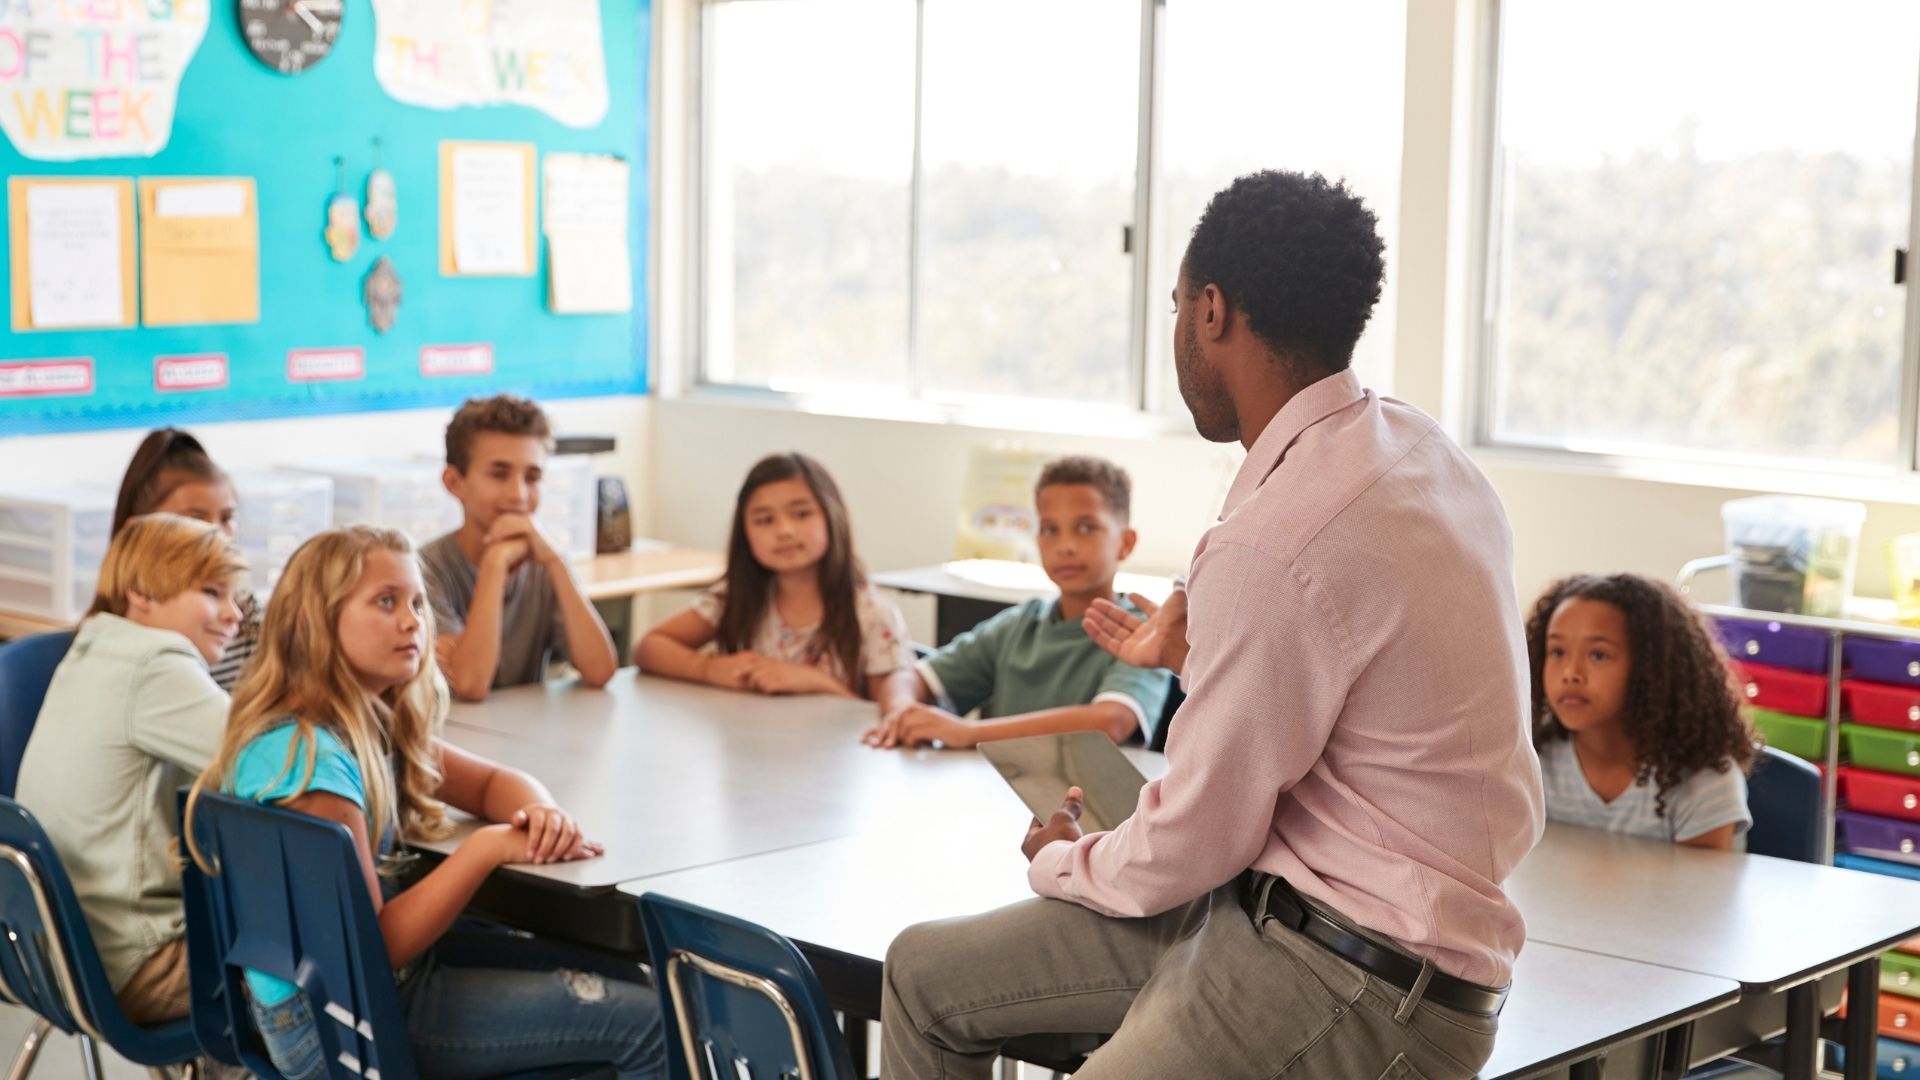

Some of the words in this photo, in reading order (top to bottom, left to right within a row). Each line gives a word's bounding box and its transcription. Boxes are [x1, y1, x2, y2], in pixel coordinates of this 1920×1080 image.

[74, 29, 164, 81] THE
[388, 34, 460, 84] TH
[13, 86, 152, 141] WEEK
